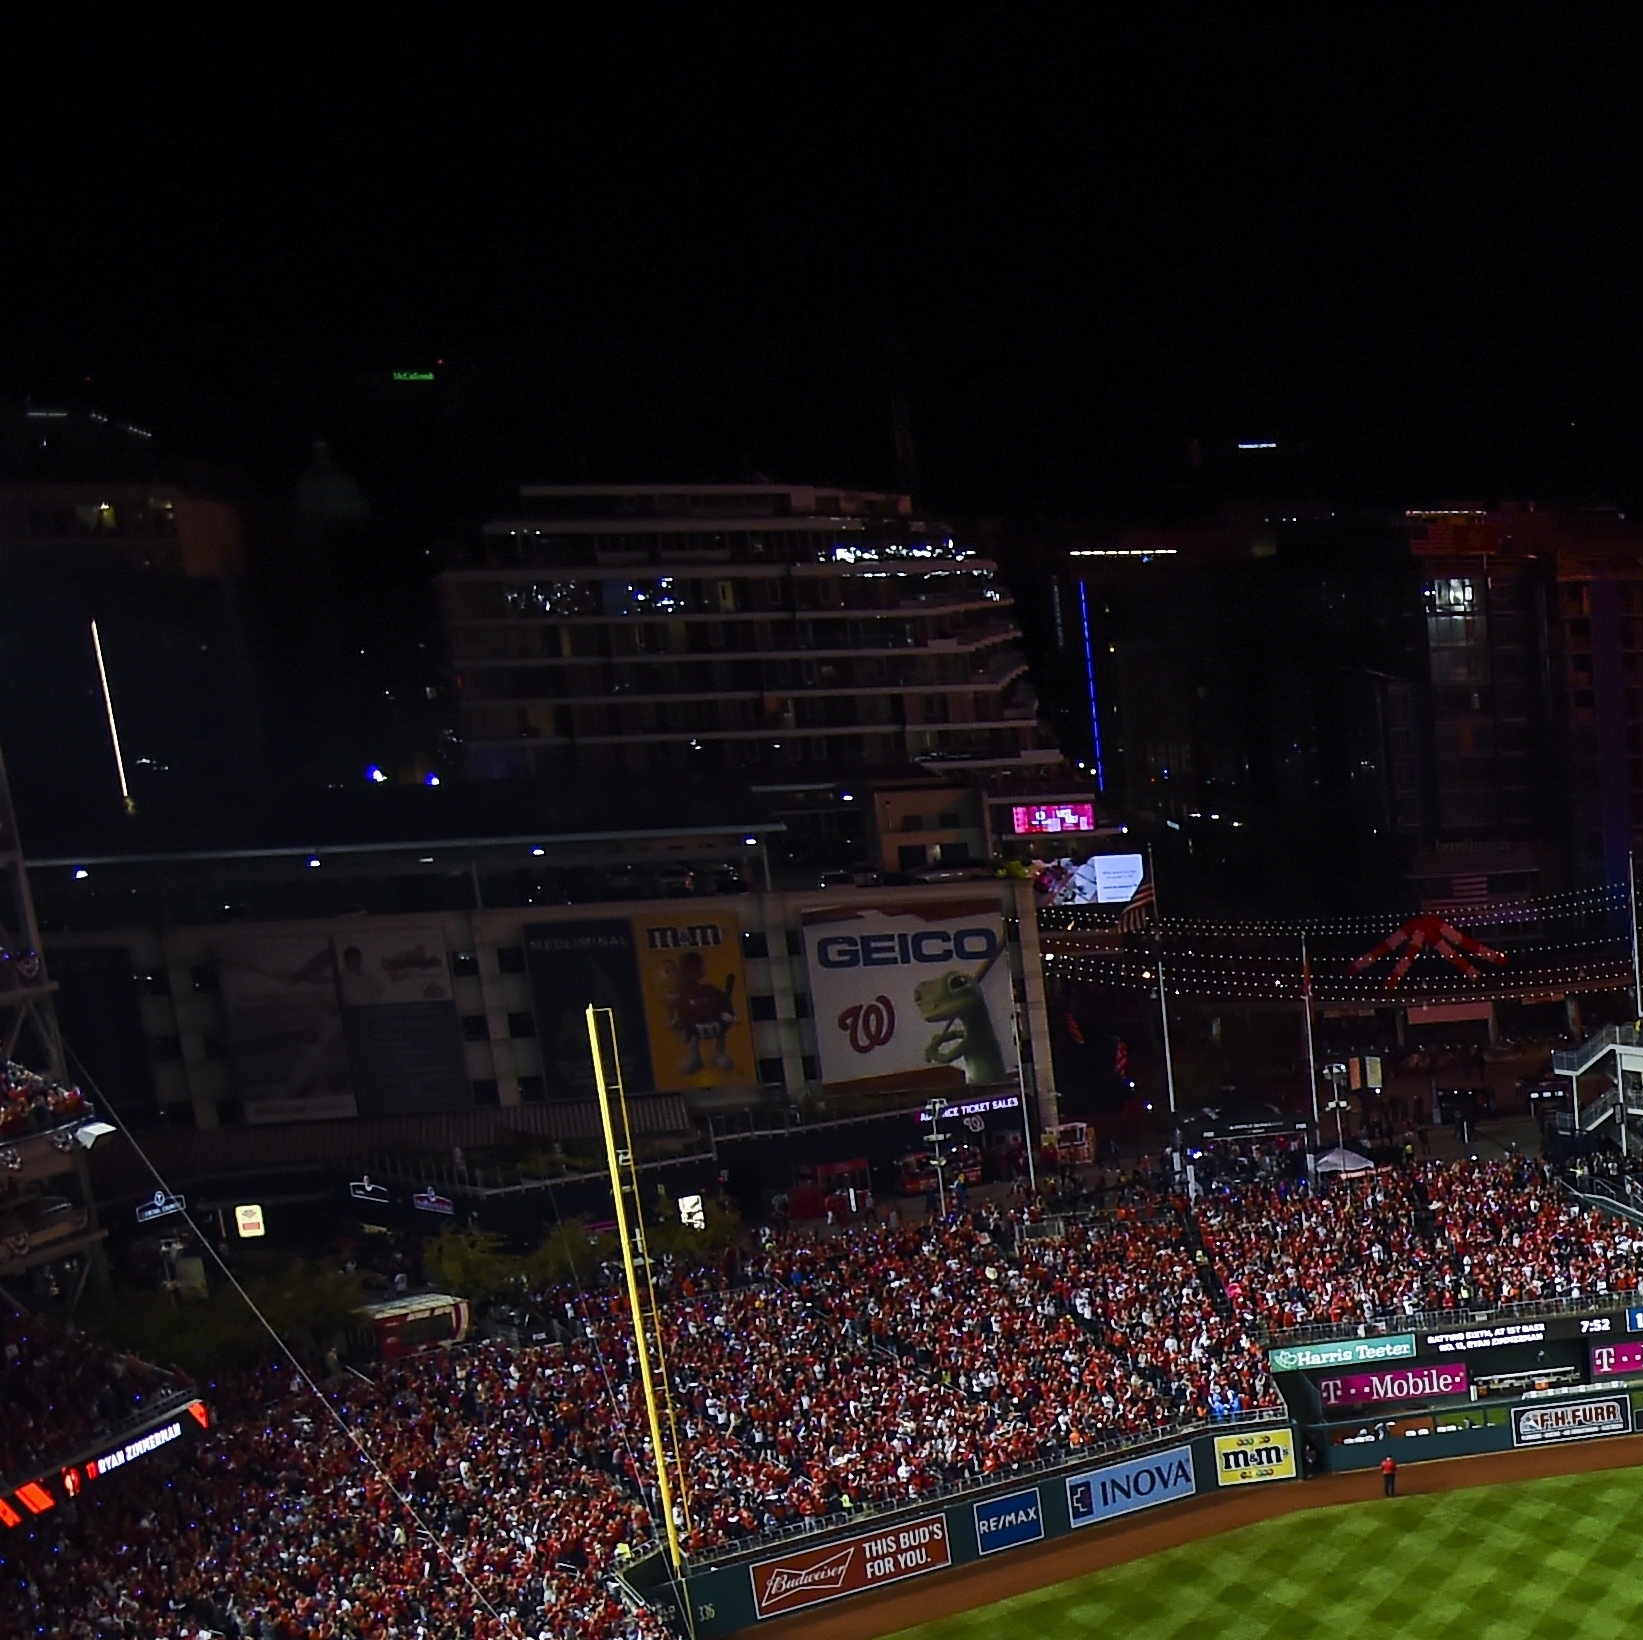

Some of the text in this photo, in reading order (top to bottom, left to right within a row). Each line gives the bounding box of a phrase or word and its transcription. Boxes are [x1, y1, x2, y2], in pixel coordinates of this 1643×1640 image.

[817, 927, 997, 969] GEICO
[1579, 1319, 1611, 1333] 7:52
[1297, 1341, 1411, 1367] Harris Teeter
[98, 1450, 126, 1475] RYAN
[1100, 1460, 1189, 1507] INOVA
[979, 1508, 1038, 1534] RE/MAX
[862, 1523, 944, 1559] THIS BUD'S
[767, 1562, 848, 1596] Budweiser
[866, 1549, 932, 1580] FOR YOU.
